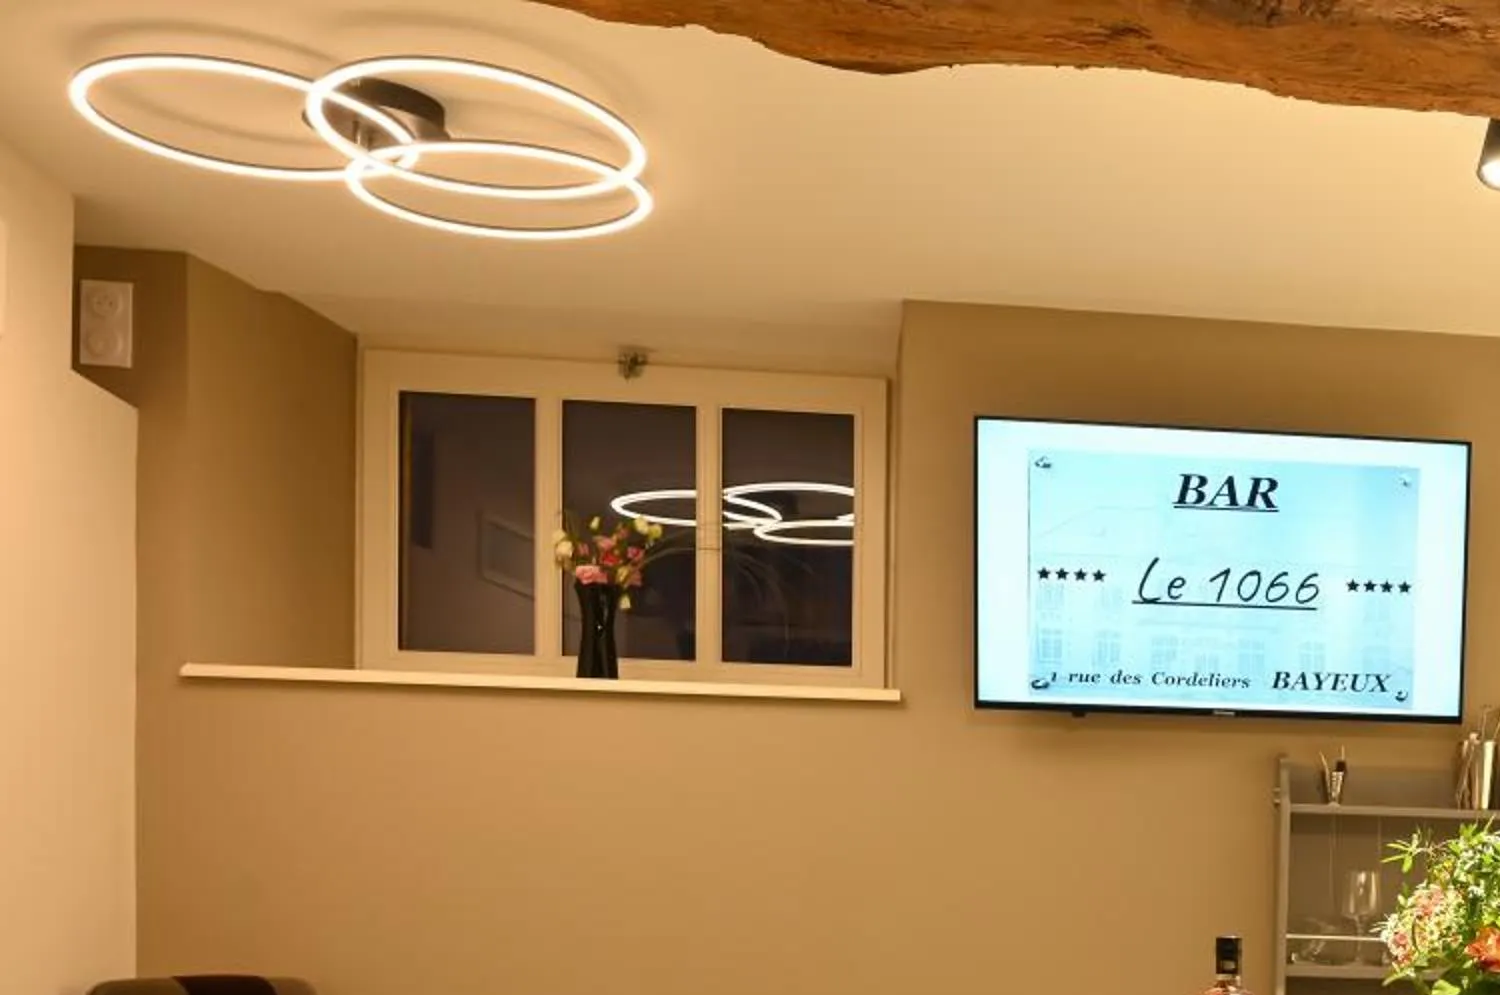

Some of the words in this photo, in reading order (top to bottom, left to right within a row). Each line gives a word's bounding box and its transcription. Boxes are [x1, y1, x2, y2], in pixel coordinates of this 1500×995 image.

[1172, 473, 1279, 509] BAR
[1138, 557, 1186, 603] Le
[1209, 568, 1320, 604] 1066
[1068, 671, 1101, 684] rue
[1110, 669, 1142, 685] des
[1151, 671, 1251, 689] Cordeliers
[1271, 671, 1393, 693] BAYEUX
